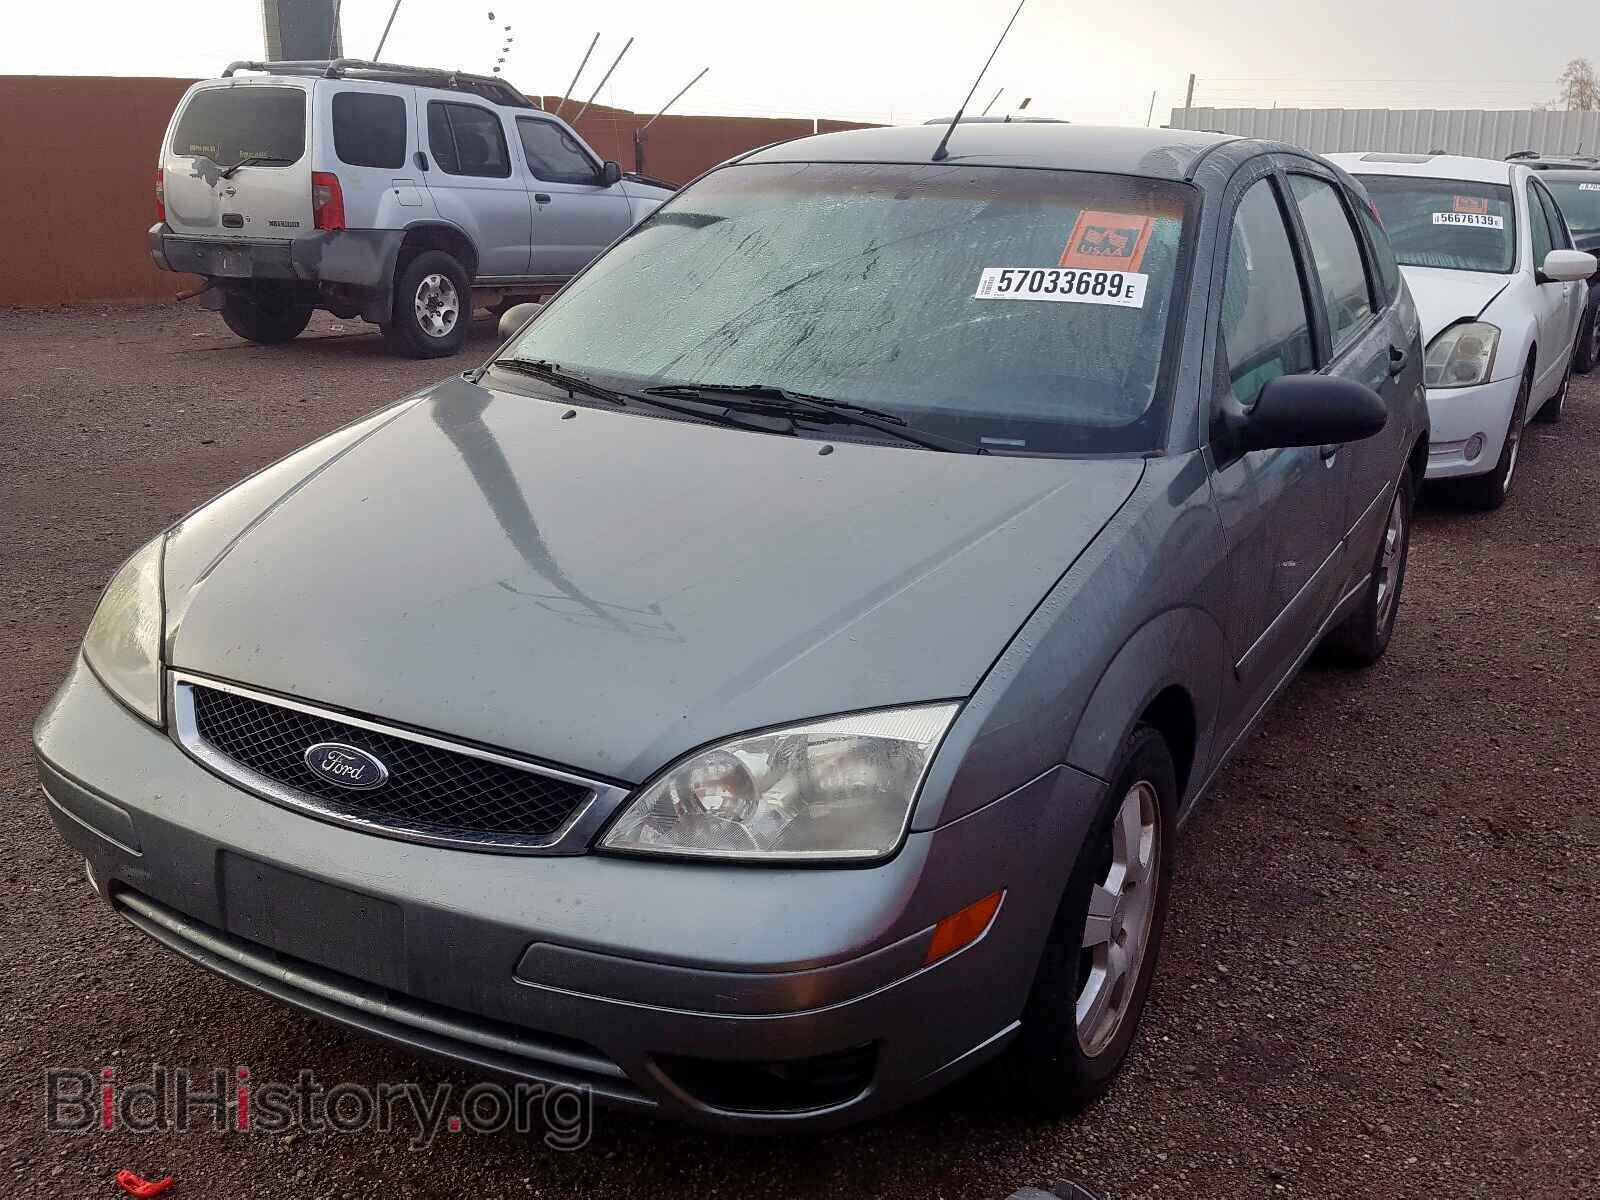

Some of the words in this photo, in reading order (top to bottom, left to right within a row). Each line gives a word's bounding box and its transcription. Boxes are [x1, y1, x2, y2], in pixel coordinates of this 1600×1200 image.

[1441, 213, 1494, 226] 56676139
[997, 269, 1124, 298] 57033689
[1125, 285, 1135, 299] E
[321, 750, 366, 780] Ford
